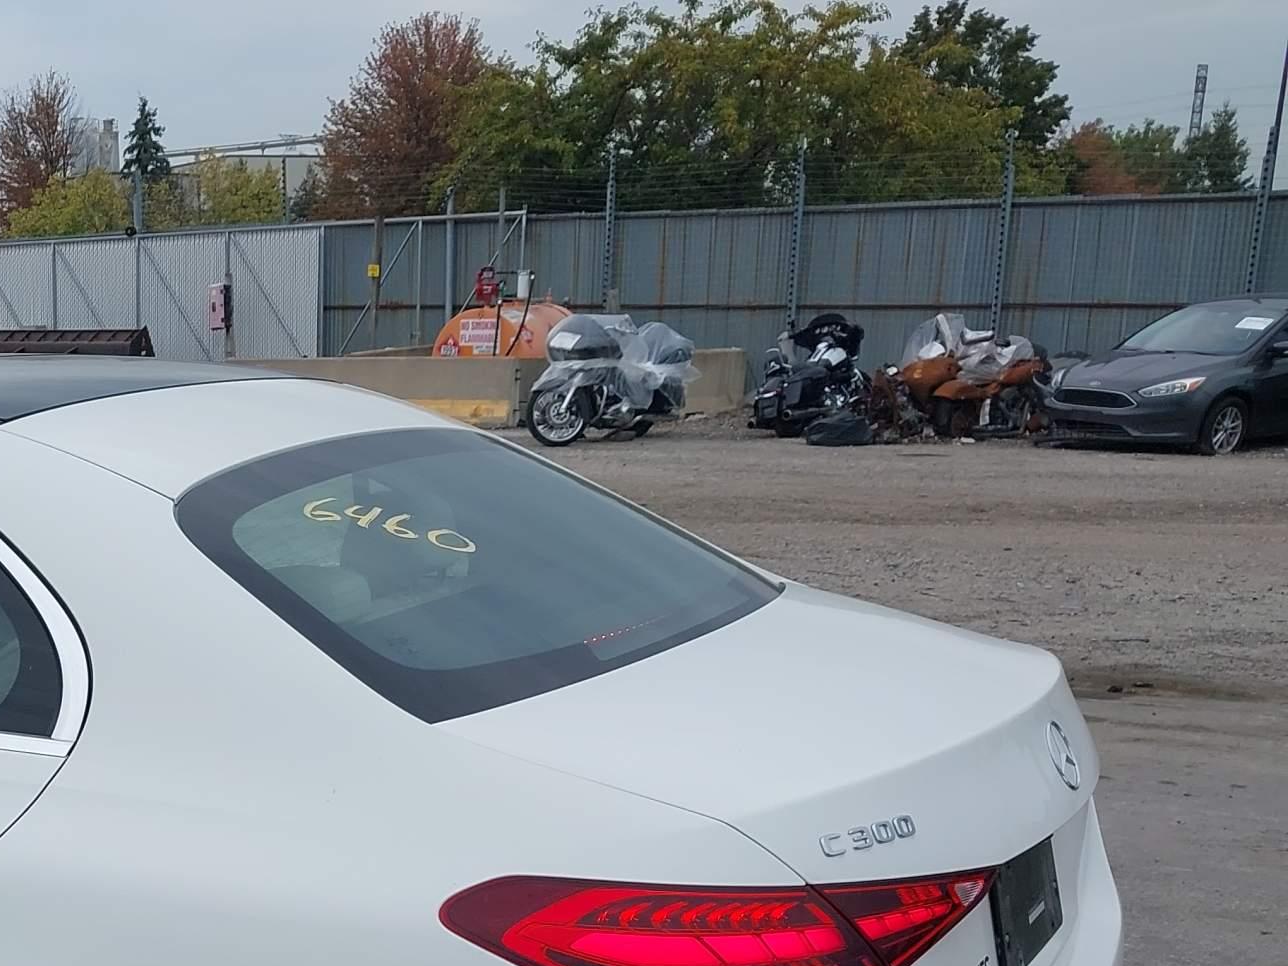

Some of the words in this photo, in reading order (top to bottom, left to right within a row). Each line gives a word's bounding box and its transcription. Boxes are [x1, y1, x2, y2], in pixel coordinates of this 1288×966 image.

[302, 497, 477, 553] 6460
[818, 832, 847, 858] C
[847, 815, 917, 851] 300
